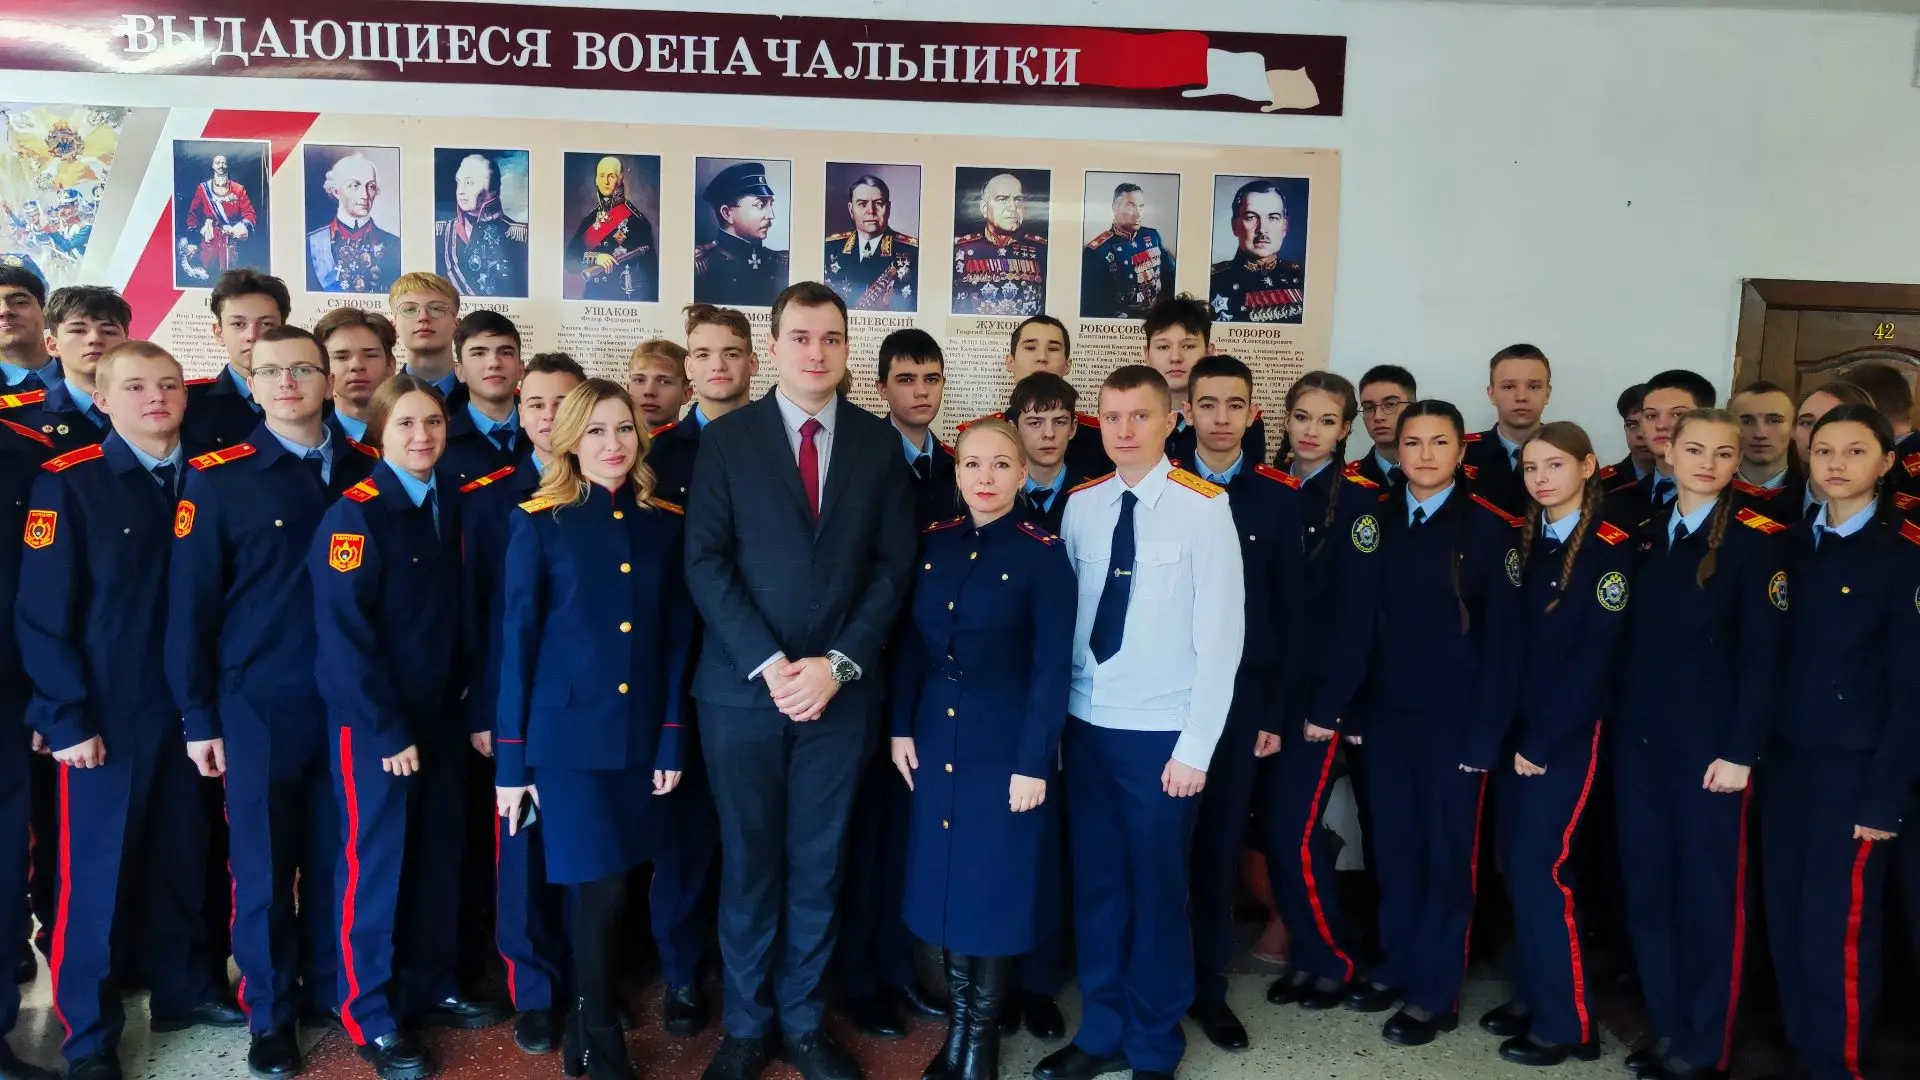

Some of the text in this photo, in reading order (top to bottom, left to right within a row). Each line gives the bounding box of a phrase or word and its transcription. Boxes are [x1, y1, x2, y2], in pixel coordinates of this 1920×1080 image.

[120, 14, 1080, 87] ВЫДАЮЩИЕСЯ ВОЕНАЧАЛЬНИКИ
[327, 299, 381, 309] СУВОРОВ
[585, 307, 638, 316] УШАКОВ
[850, 315, 914, 326] ИЛЕВСКИЙ
[976, 320, 1020, 329] ЖУКОВ
[1080, 324, 1147, 334] РОКОССОВС
[1229, 329, 1280, 338] ГОВОРОВ
[1873, 322, 1895, 340] 42
